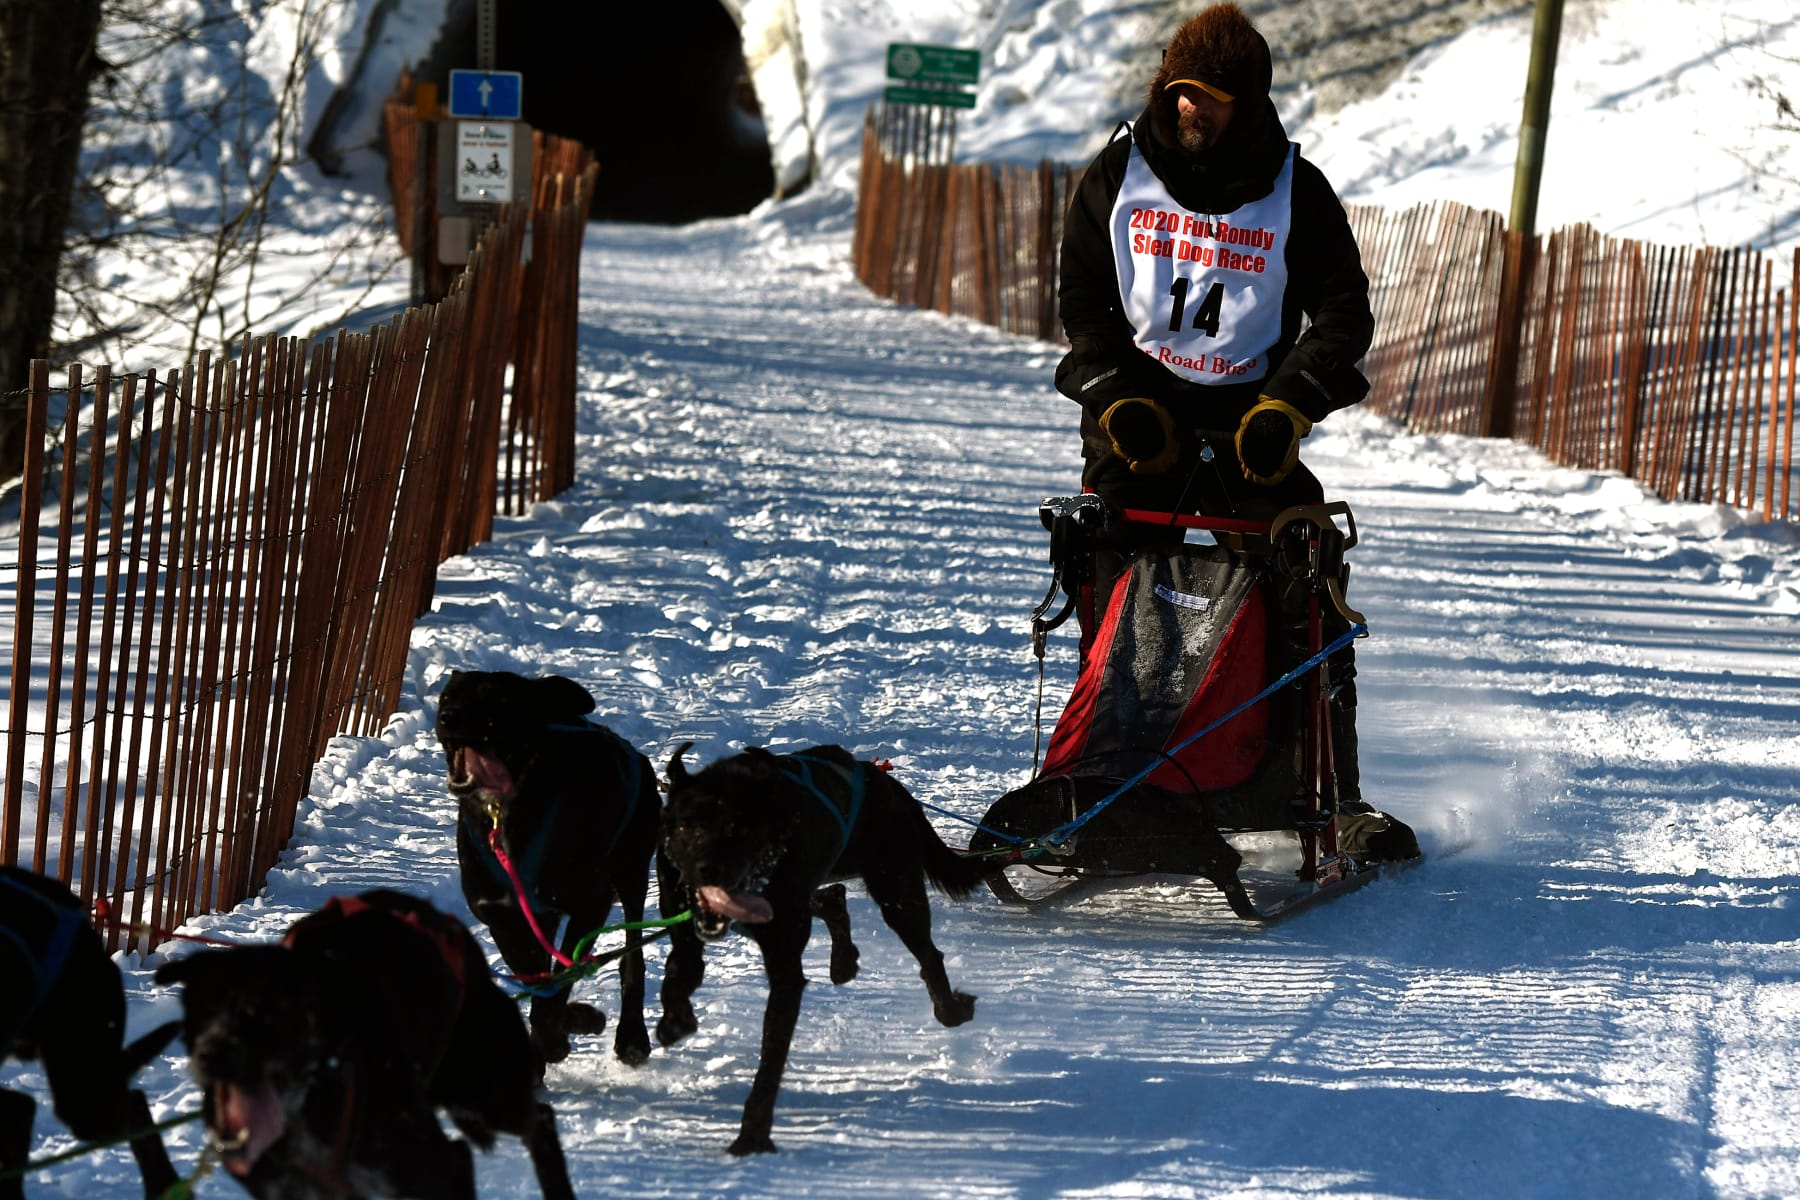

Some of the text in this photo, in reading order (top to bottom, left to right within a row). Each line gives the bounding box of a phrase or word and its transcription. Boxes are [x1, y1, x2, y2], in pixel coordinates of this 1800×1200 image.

[1130, 208, 1275, 251] 2020 Fur Rondy
[1133, 233, 1266, 273] Sled Dog Race
[1168, 277, 1225, 338] 14
[1158, 346, 1206, 372] Road
